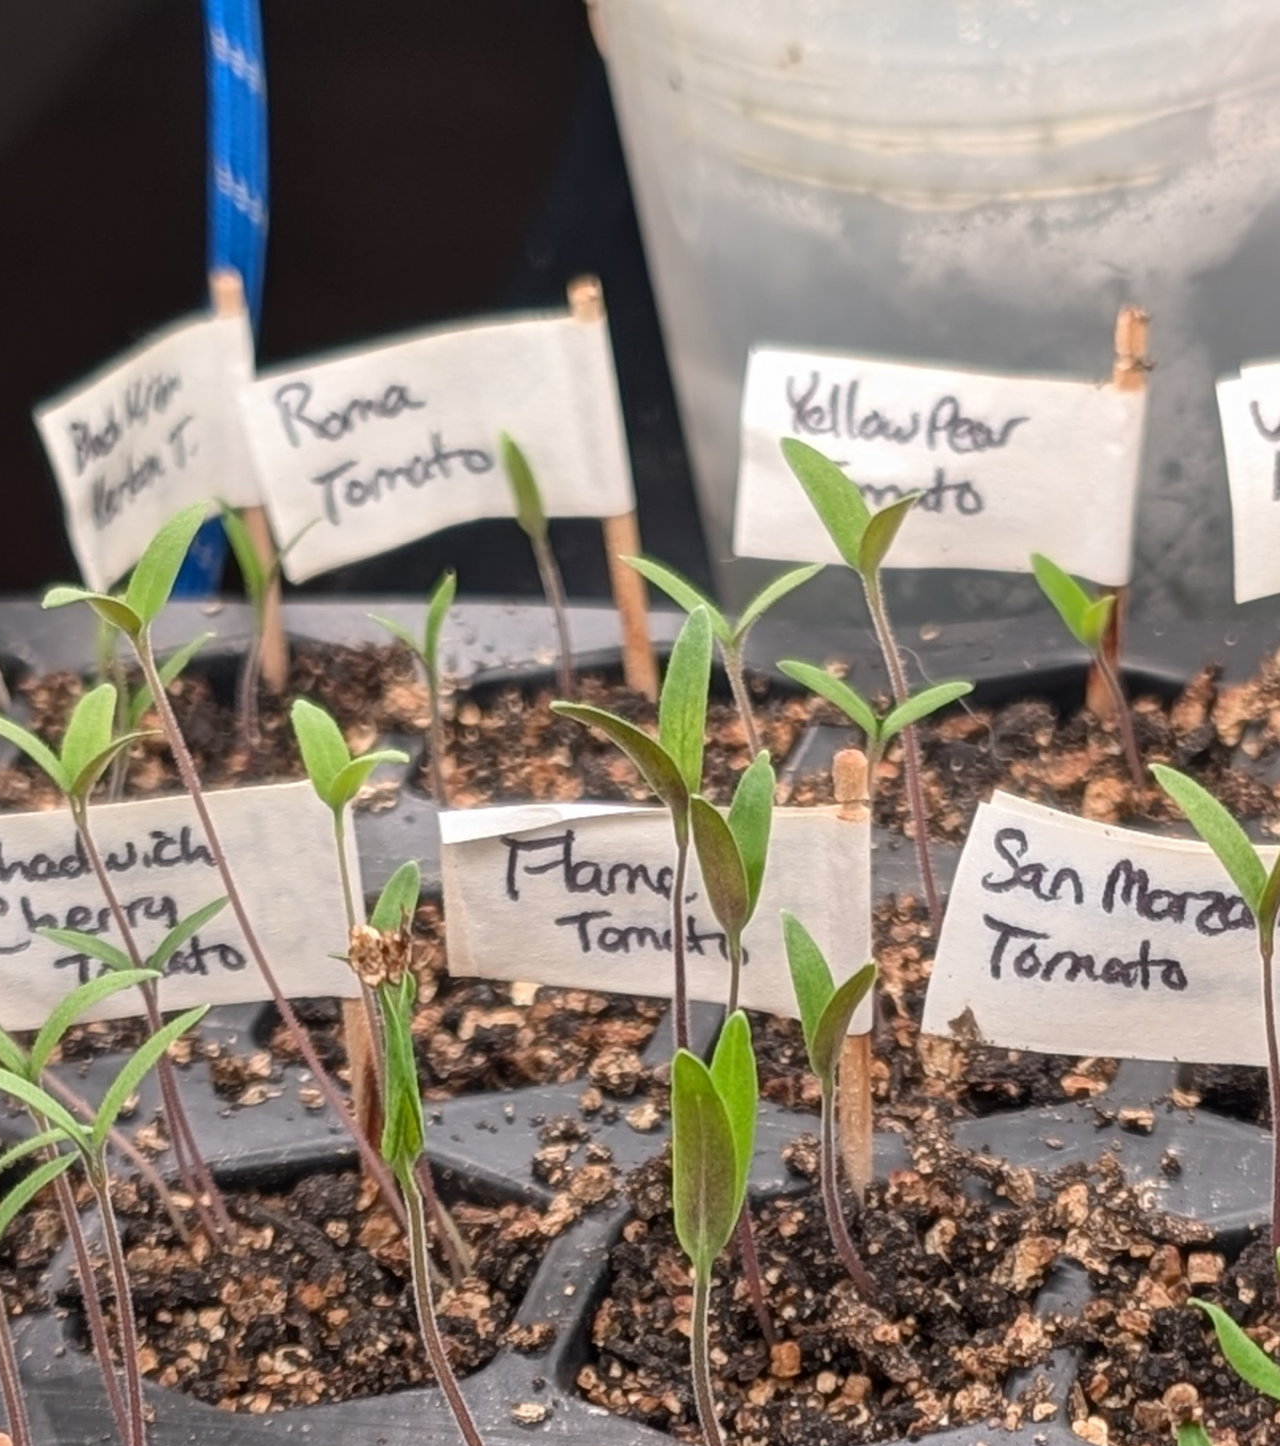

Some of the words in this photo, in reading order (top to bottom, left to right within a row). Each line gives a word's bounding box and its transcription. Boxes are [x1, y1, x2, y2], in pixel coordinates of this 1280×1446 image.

[274, 381, 426, 448] Roma
[786, 370, 920, 437] Yellow
[310, 432, 494, 526] Tomato
[981, 827, 1085, 905] San
[983, 913, 1189, 991] Tomato
